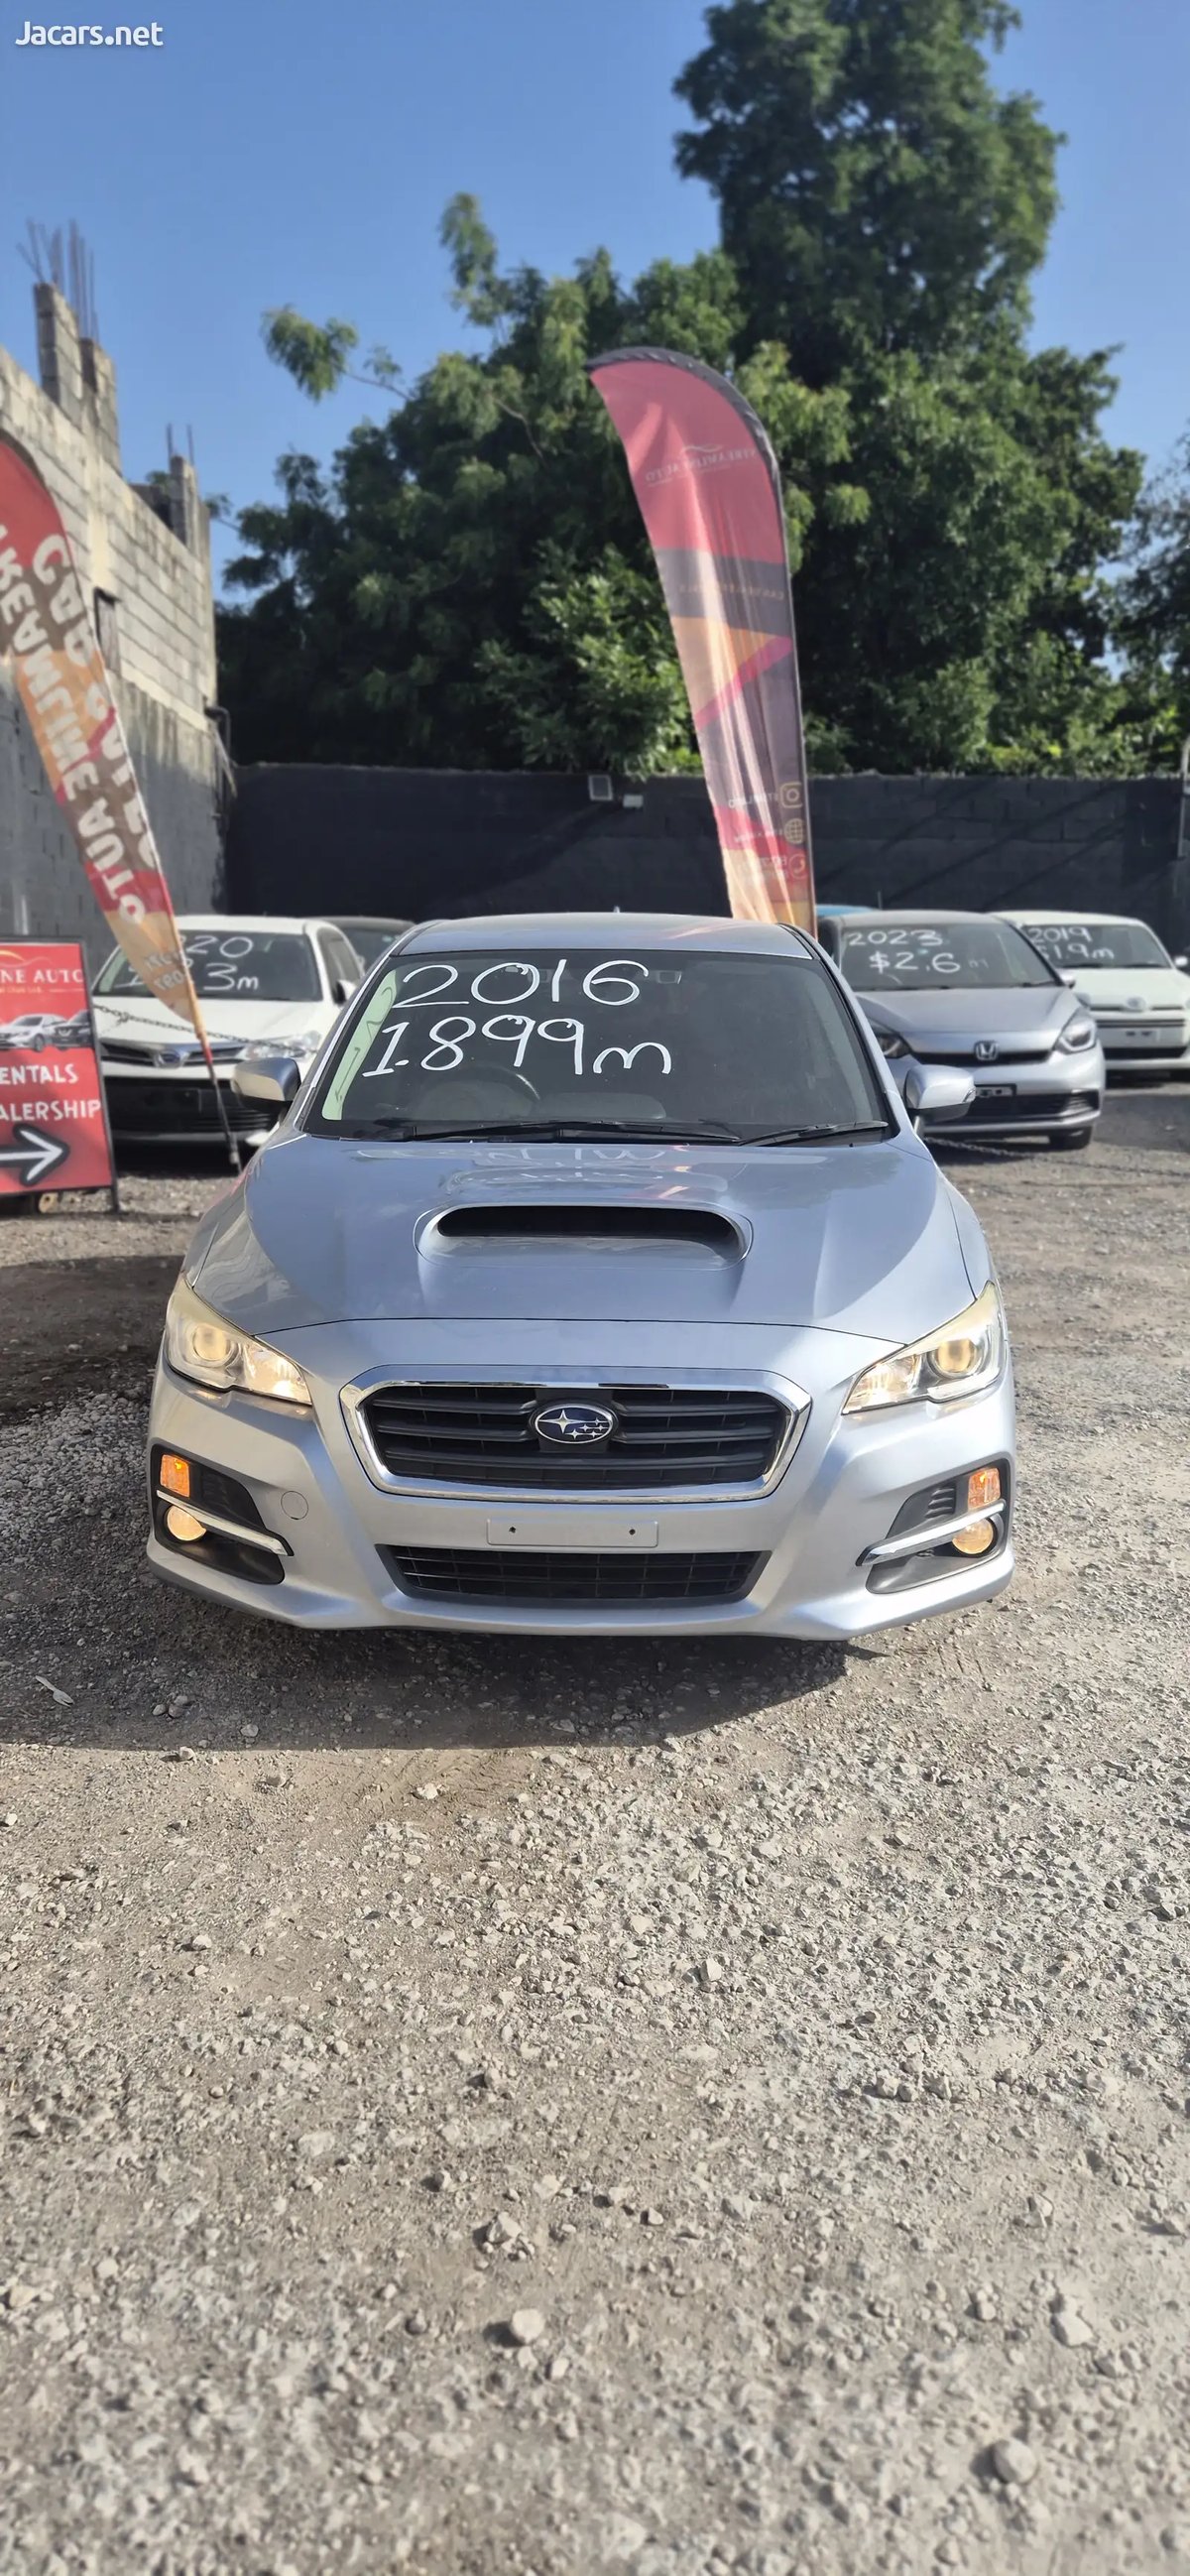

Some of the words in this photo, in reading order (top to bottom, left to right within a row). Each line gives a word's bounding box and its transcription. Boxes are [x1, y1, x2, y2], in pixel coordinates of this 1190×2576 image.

[847, 928, 944, 946] 2023
[1027, 925, 1093, 943] 2019
[34, 968, 84, 984] AUTO
[391, 958, 650, 1009] 2016
[362, 1014, 672, 1077] 1.899m
